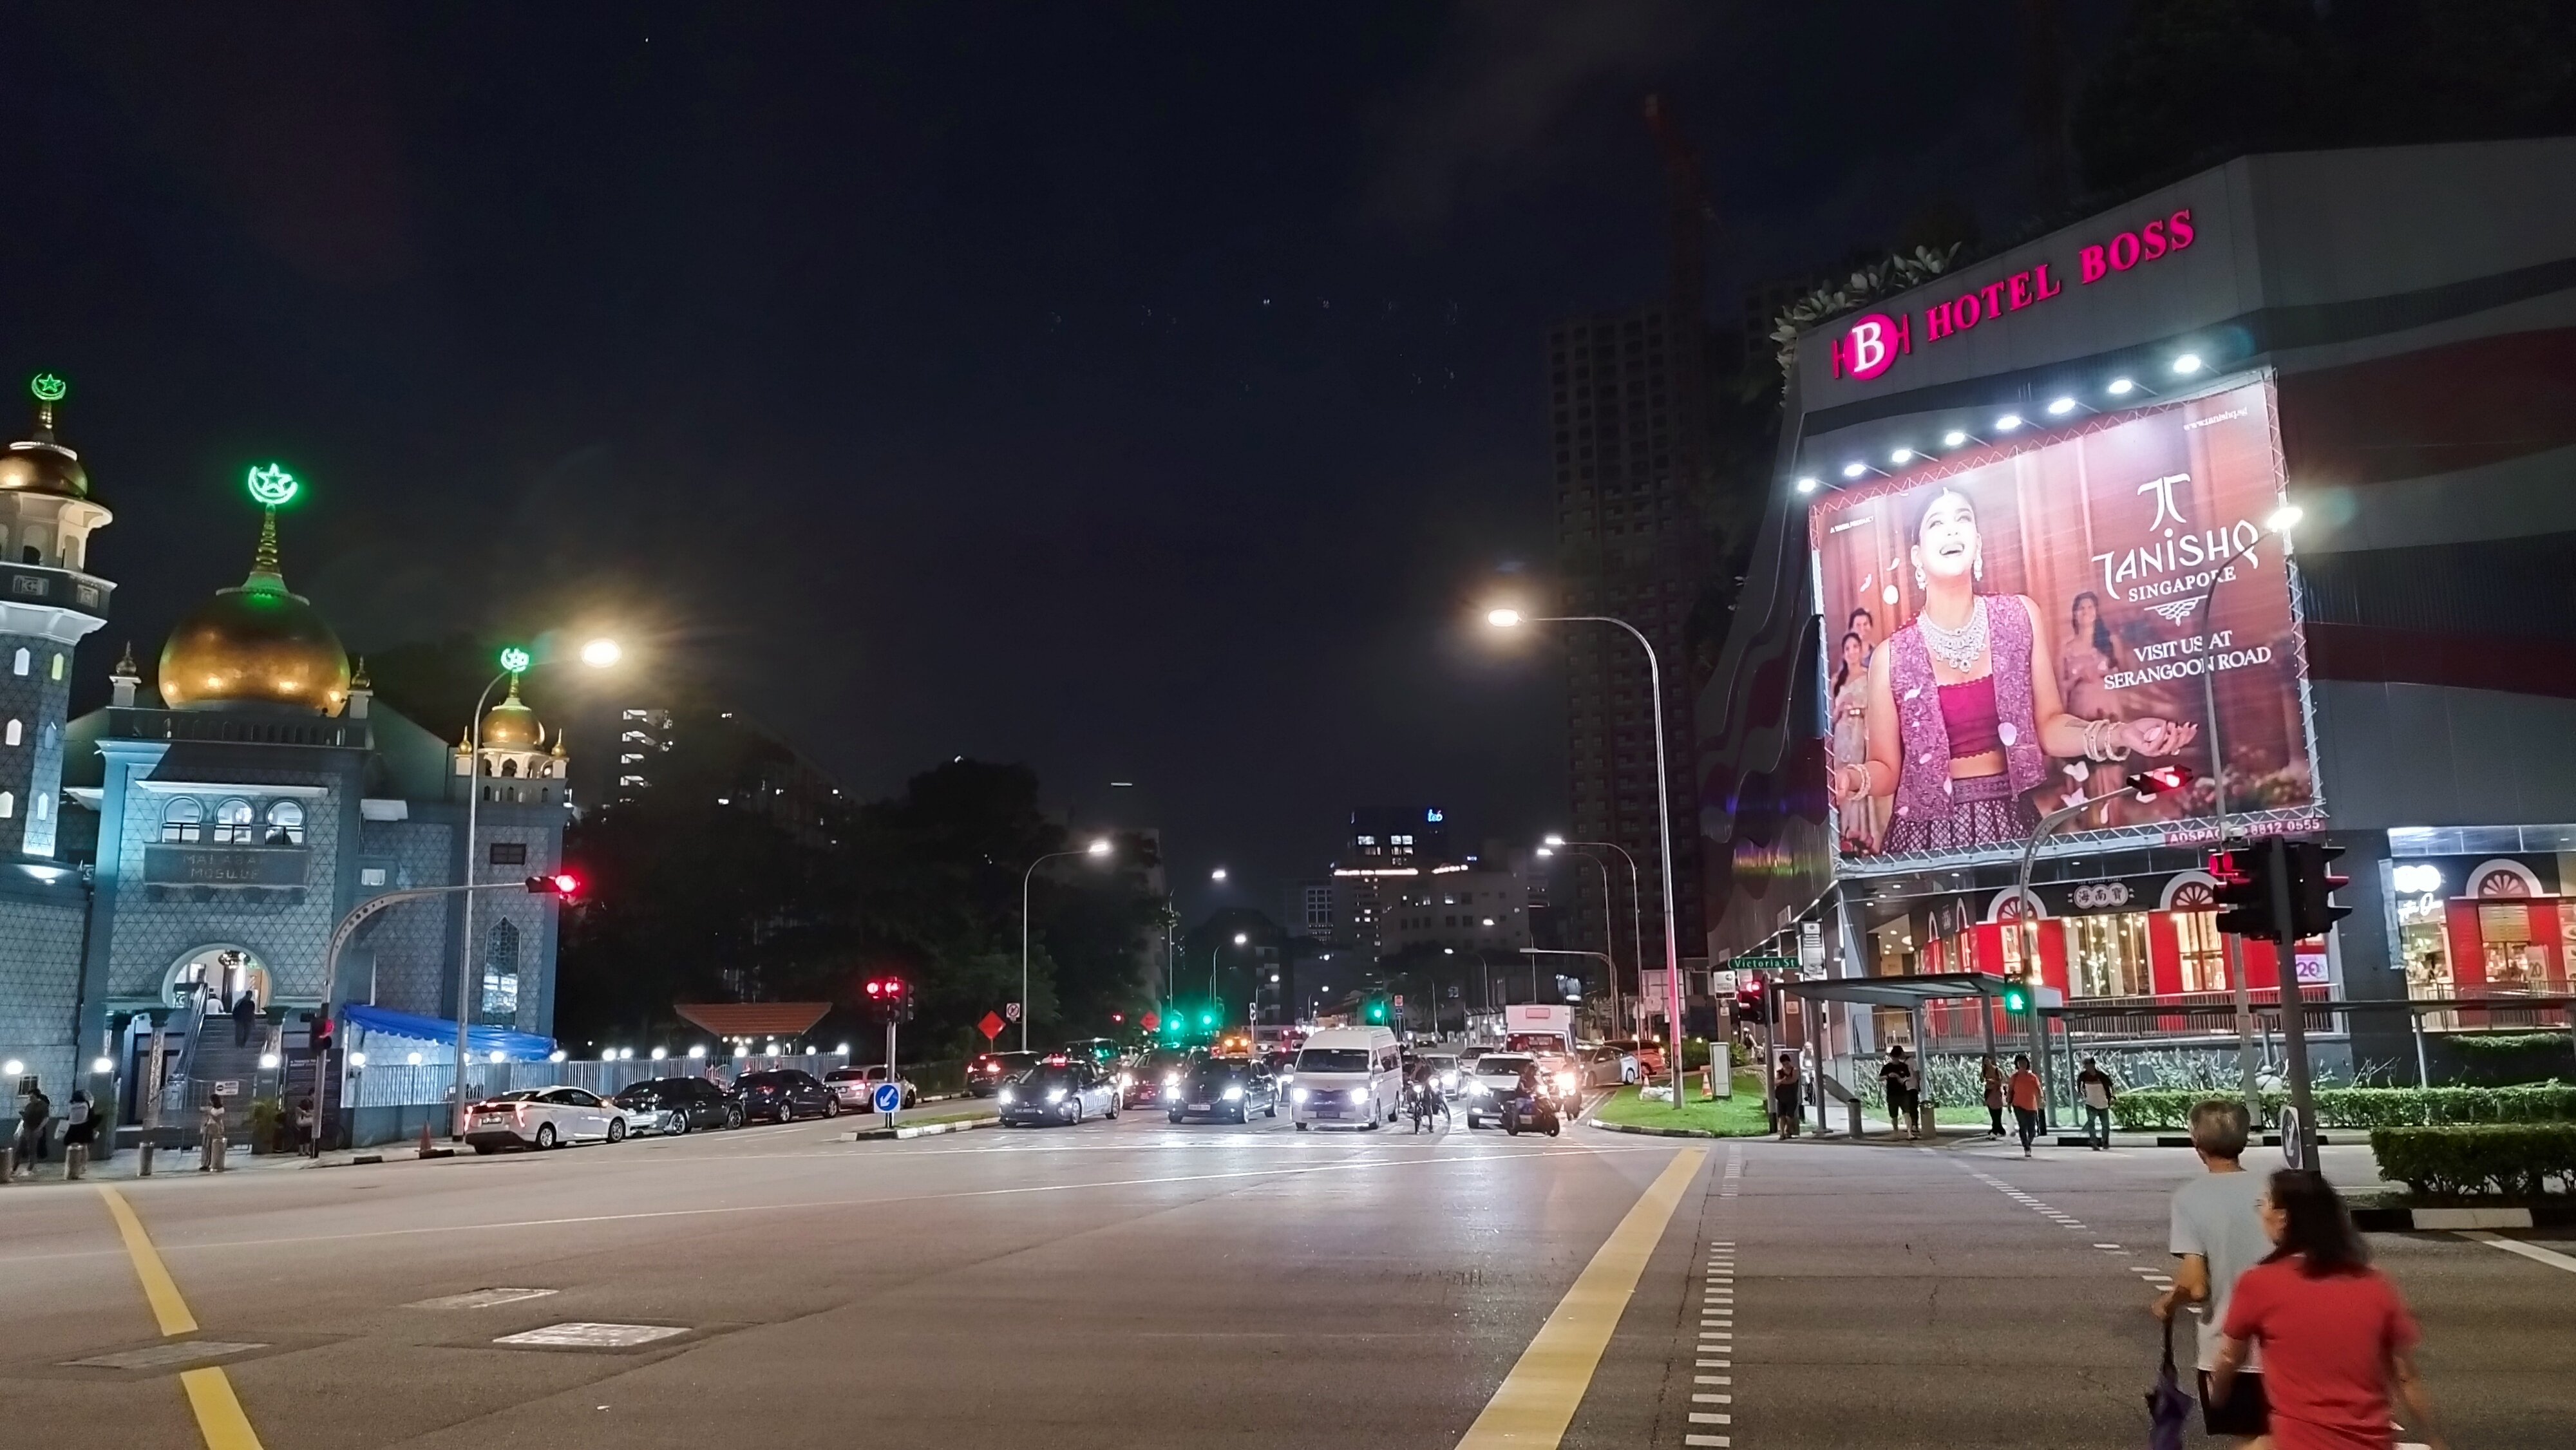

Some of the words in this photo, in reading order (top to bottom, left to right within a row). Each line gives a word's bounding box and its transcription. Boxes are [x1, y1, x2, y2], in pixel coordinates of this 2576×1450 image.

[1924, 263, 2062, 343] HOTEL
[2078, 208, 2195, 285] BOSS
[2133, 641, 2177, 663] VISIT
[2181, 636, 2203, 652] US
[2208, 630, 2233, 650] AT
[2103, 655, 2214, 691] SERANGOON
[2218, 646, 2272, 671] ROAD
[2170, 828, 2221, 843] ADSPAC
[2251, 821, 2283, 836] 8812
[2287, 818, 2320, 831] 0555
[1734, 959, 1780, 968] Victoria
[1784, 958, 1795, 967] St
